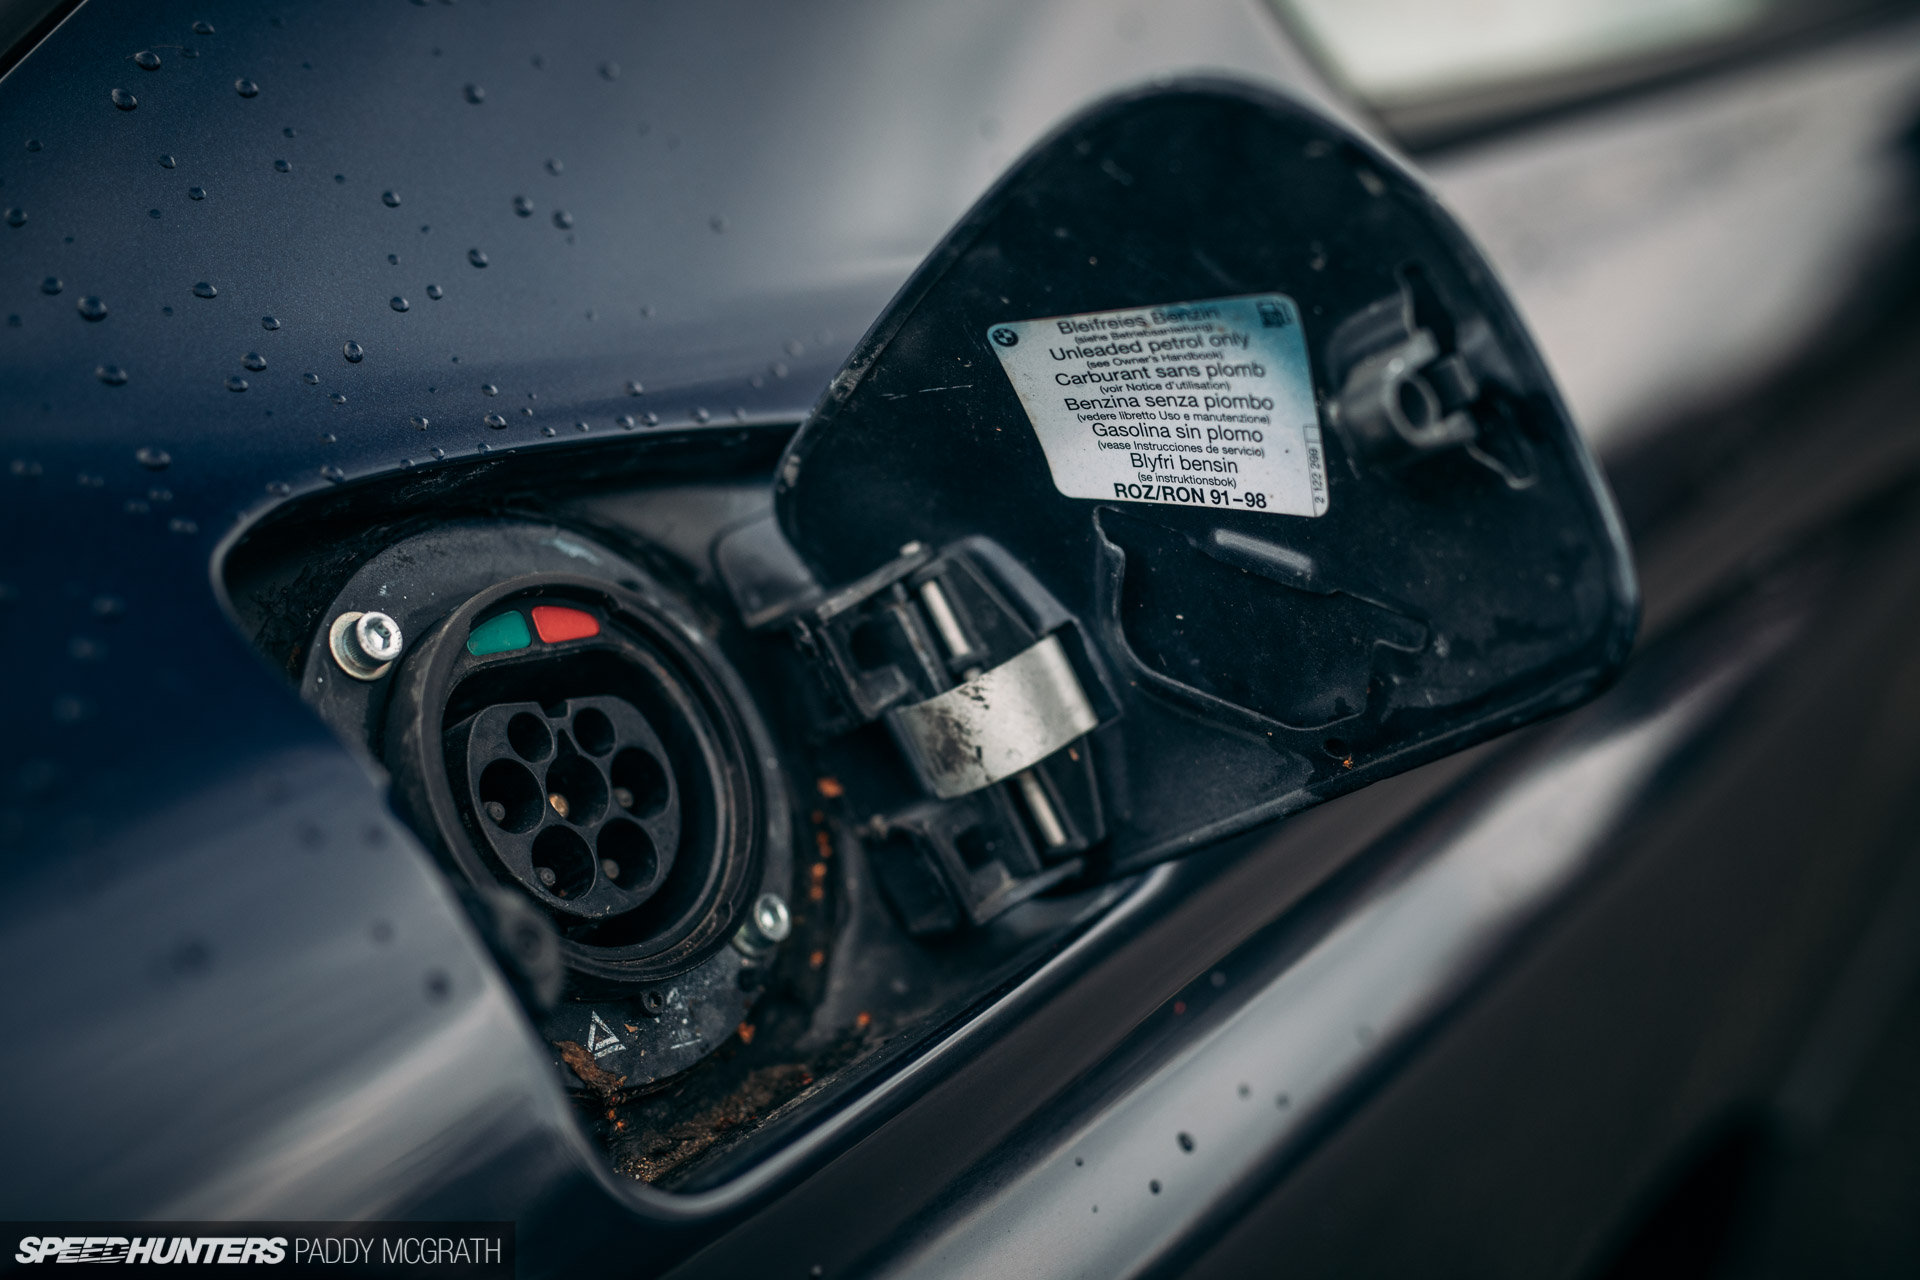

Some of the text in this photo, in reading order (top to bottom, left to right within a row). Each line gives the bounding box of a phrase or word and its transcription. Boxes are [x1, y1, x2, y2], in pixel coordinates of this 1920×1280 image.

[1057, 307, 1220, 335] Bleifreies Benzin
[1049, 332, 1249, 361] Unleaded petrol only
[1074, 335, 1108, 345] (siehe
[1086, 351, 1224, 370] (see Owner's Handbook)
[1055, 362, 1265, 386] Carburant sans plomb
[1100, 381, 1231, 395] (voir Notice d'utilisation)
[1064, 394, 1274, 411] Benzina senza piombo
[1077, 411, 1271, 426] (vedere libretto Uso e manutenzione)
[1092, 422, 1264, 443] Gasolina sin plomo
[1097, 440, 1266, 459] (vease Instrucciones de servicio)
[1130, 452, 1239, 474] Blyfri bensin
[1137, 472, 1237, 489] (se instruktionsbok)
[1113, 482, 1206, 504] ROZ/RON
